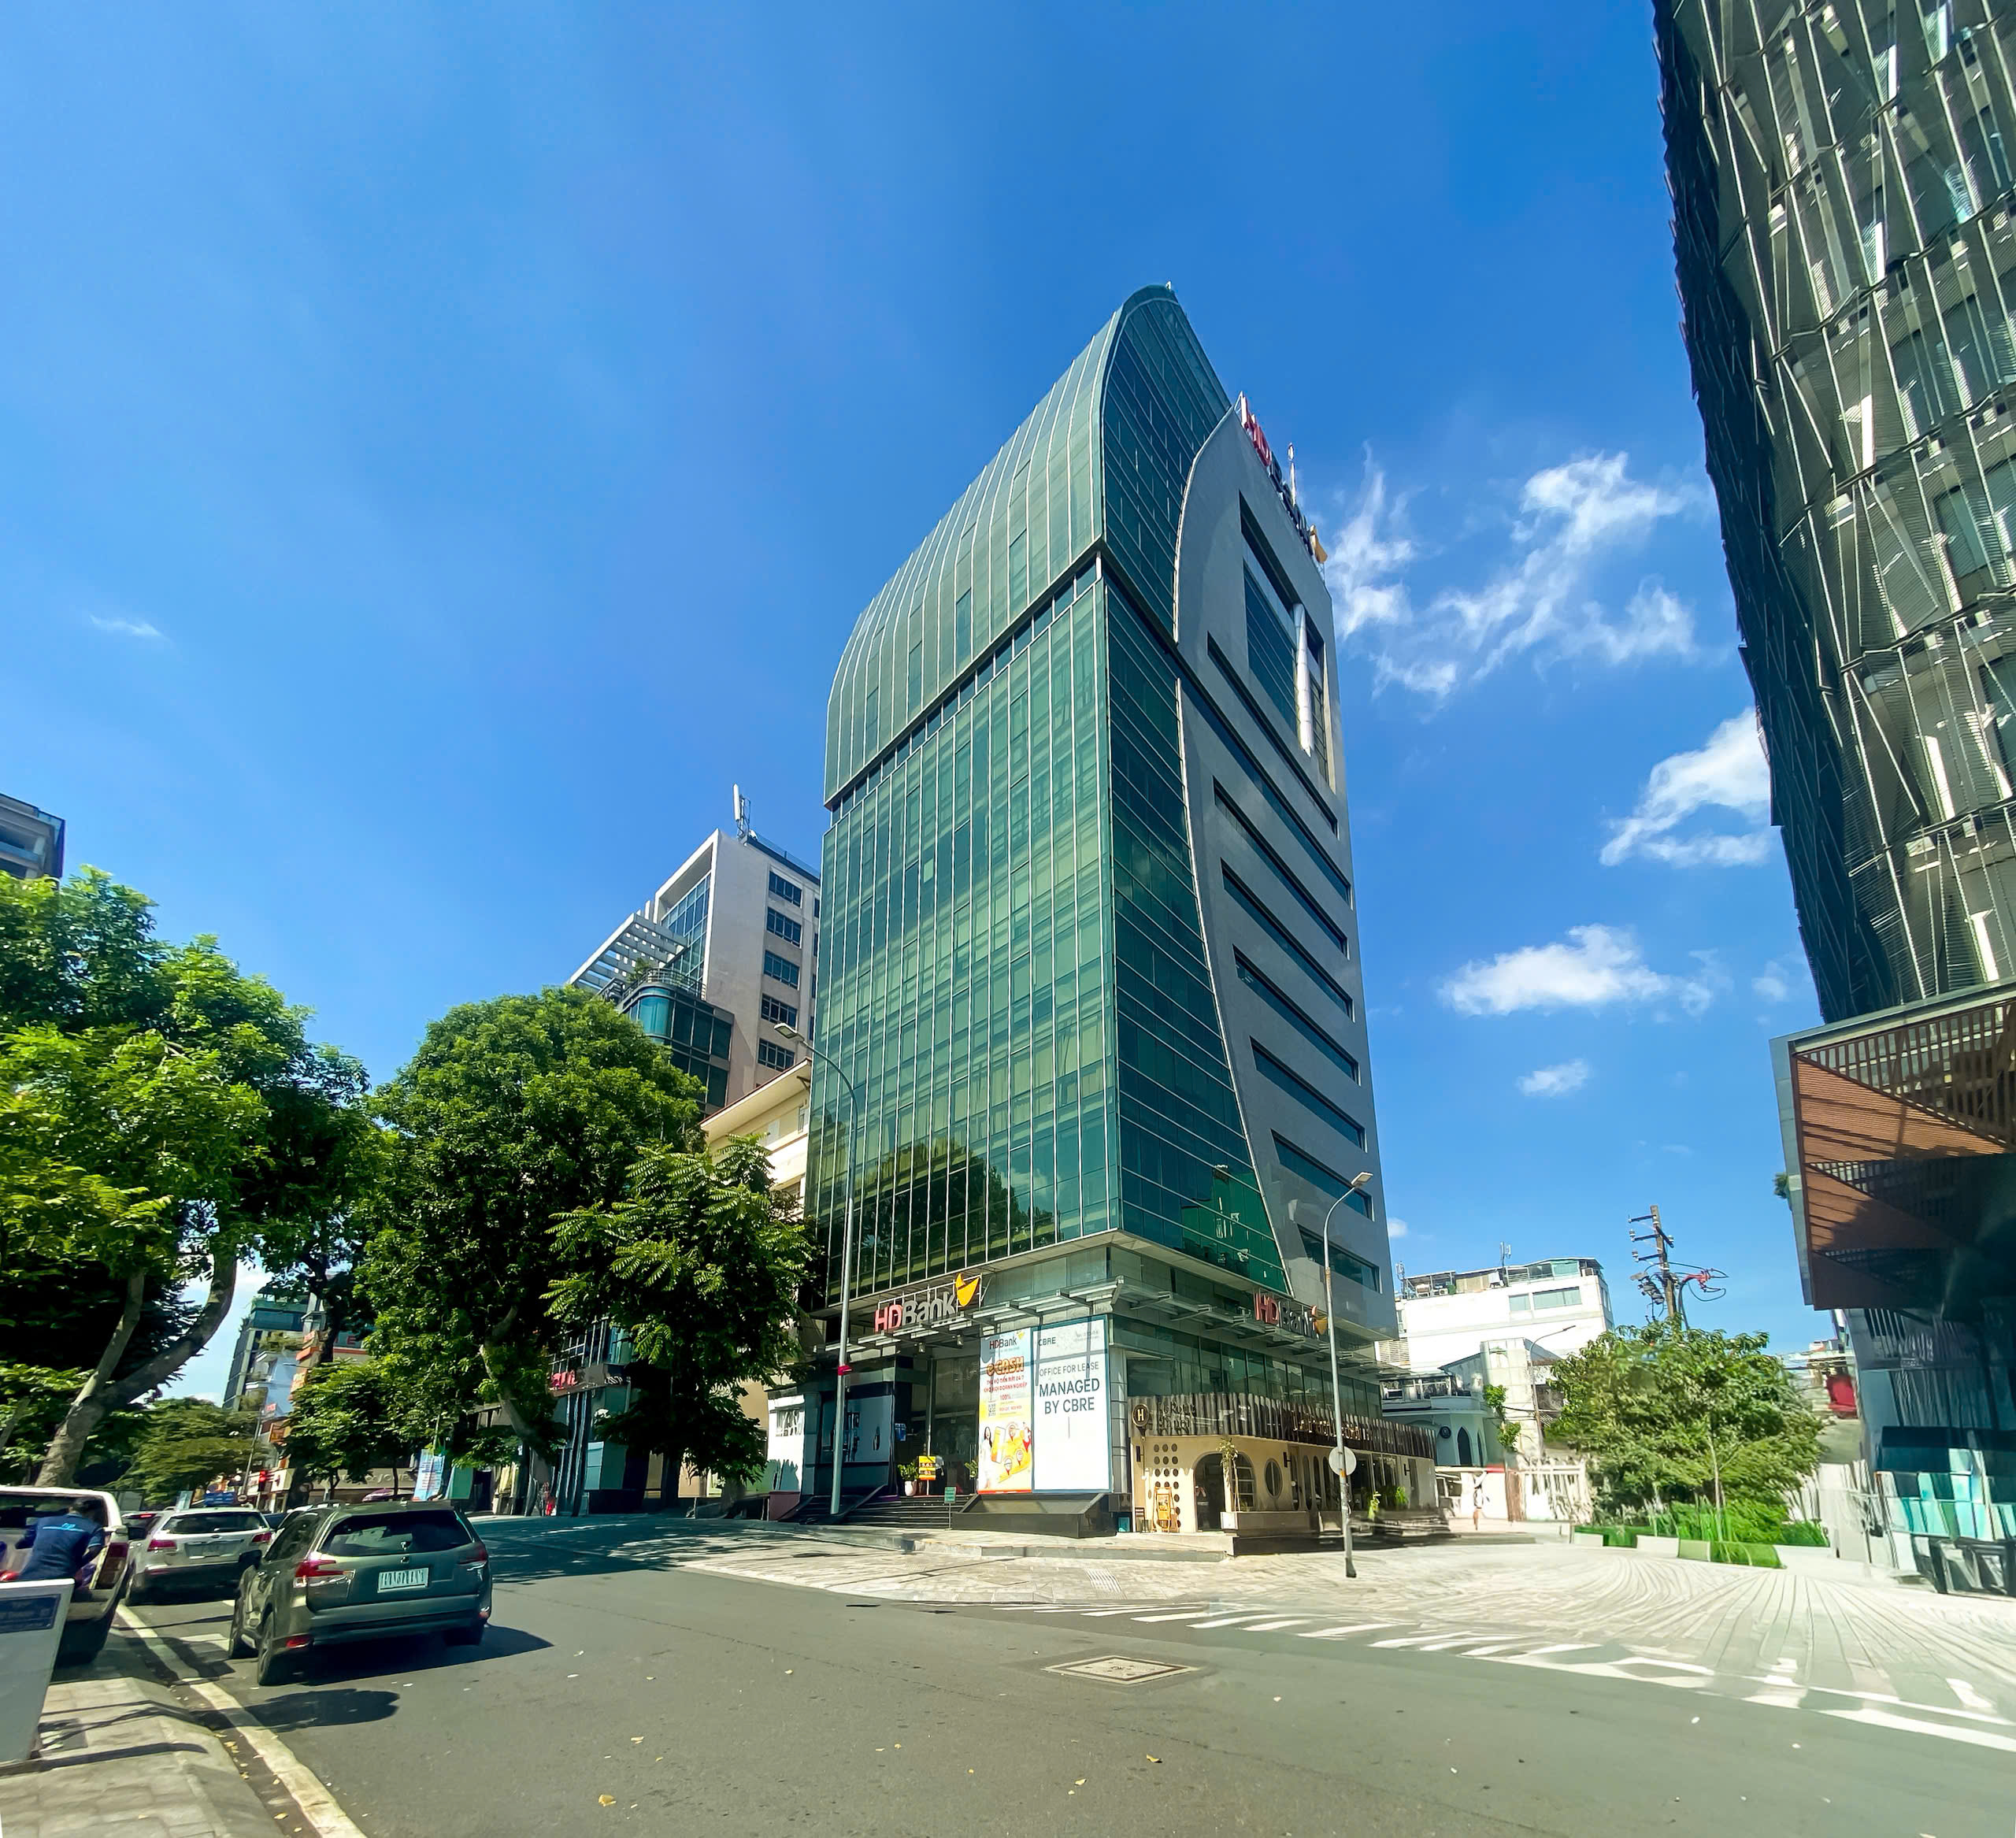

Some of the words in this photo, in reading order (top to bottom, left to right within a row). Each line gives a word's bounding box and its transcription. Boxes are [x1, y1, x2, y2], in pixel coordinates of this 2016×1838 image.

[874, 1291, 955, 1333] HDBank
[989, 1336, 1017, 1350] HDBank
[1038, 1337, 1056, 1346] CBRE
[1040, 1366, 1062, 1377] OFFICE
[1063, 1365, 1076, 1373] FOR
[1077, 1362, 1099, 1372] LEASE
[1040, 1378, 1099, 1397] MANAGED
[1045, 1400, 1059, 1414] BY
[1063, 1397, 1095, 1413] CBRE
